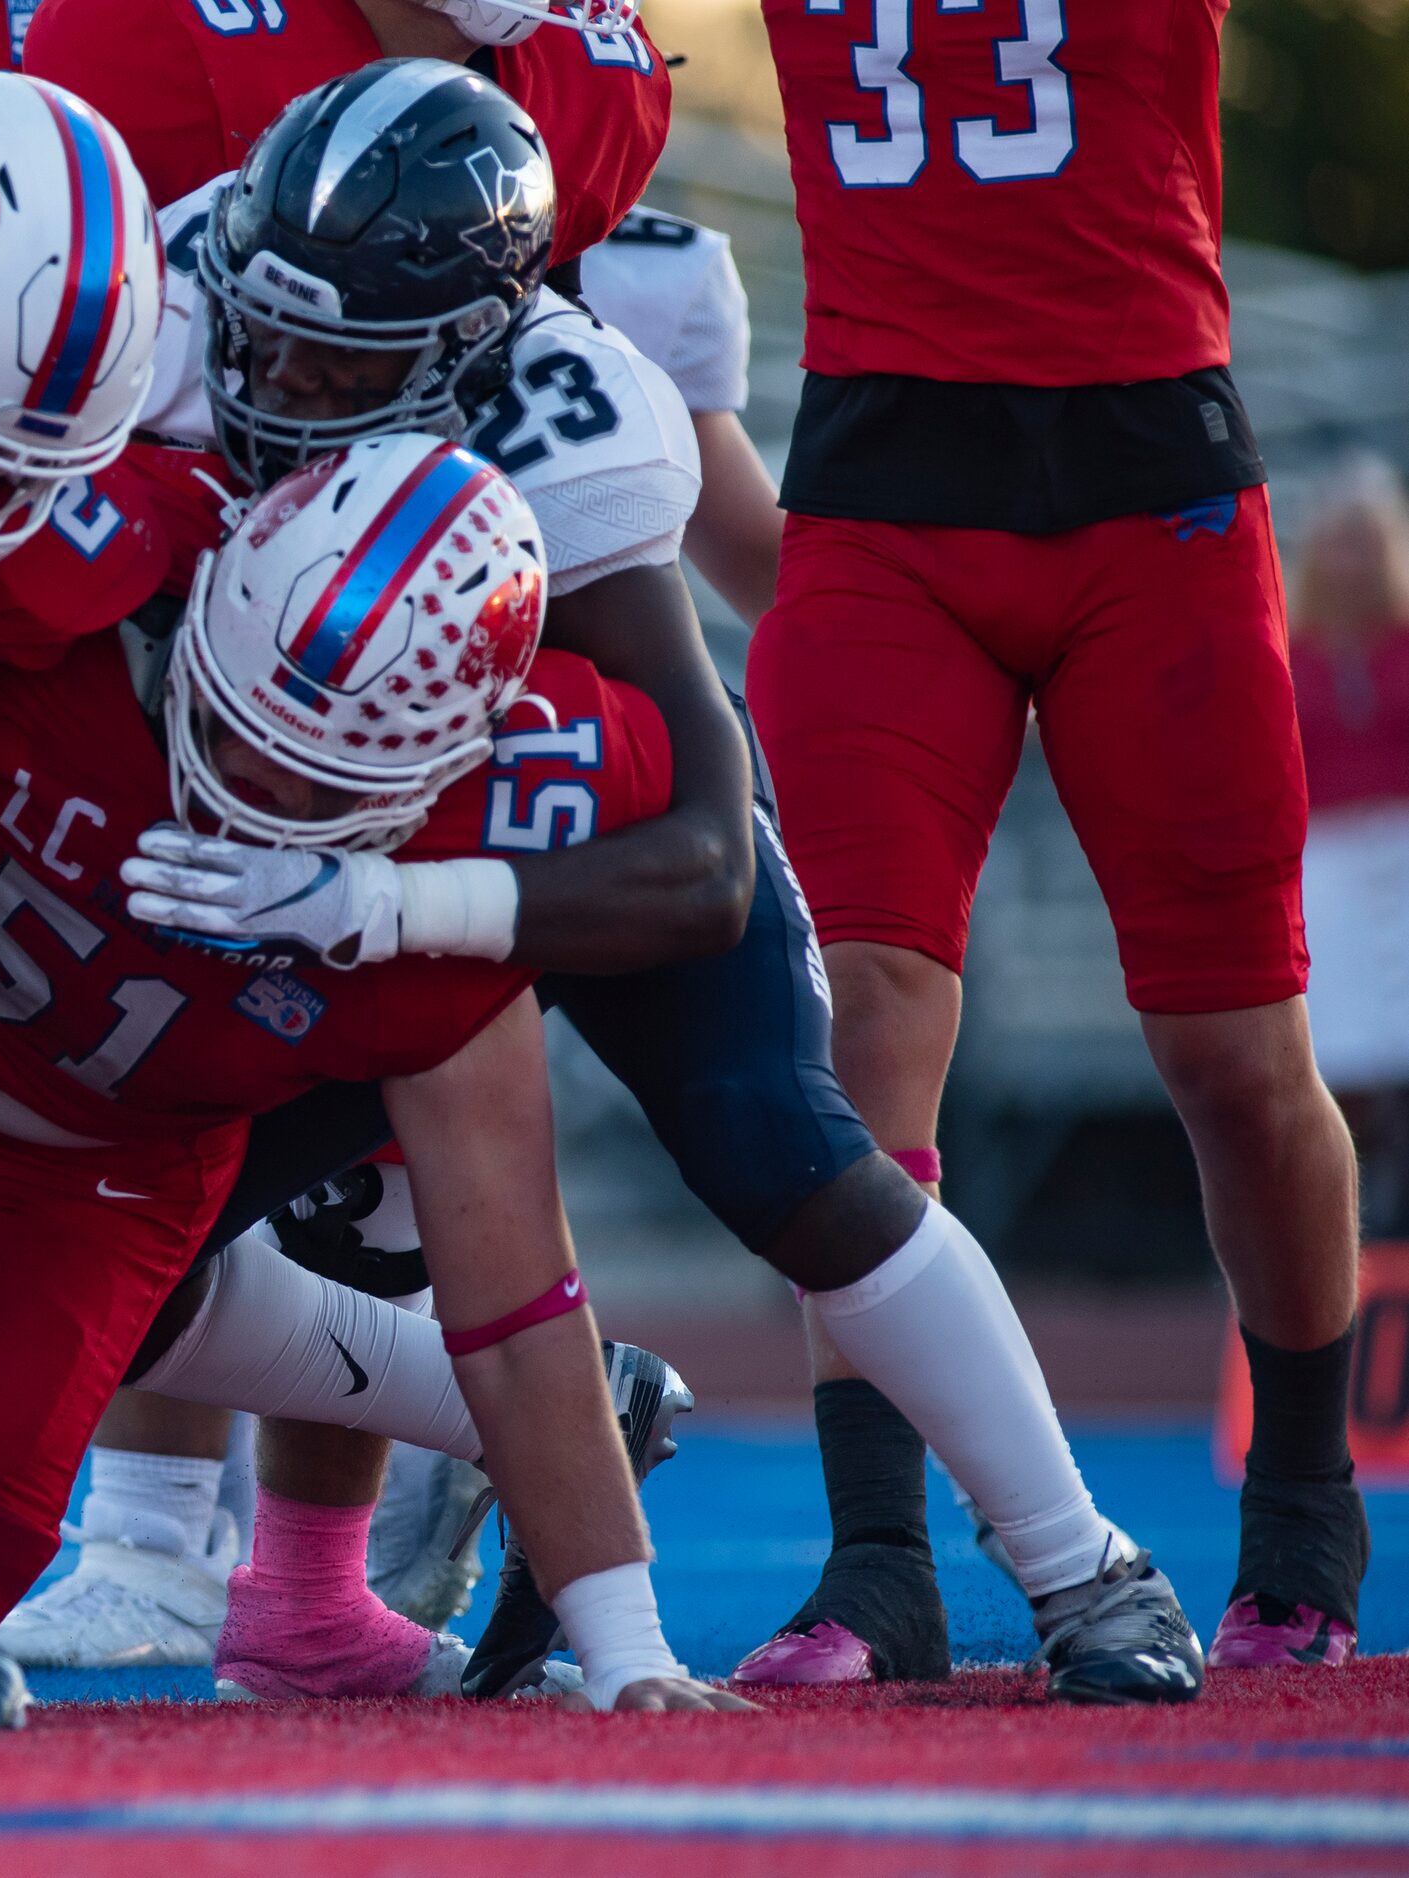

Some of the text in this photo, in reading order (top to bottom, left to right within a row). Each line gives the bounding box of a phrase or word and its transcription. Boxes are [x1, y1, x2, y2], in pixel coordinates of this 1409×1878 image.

[805, 0, 1079, 189] 33
[264, 263, 321, 307] BE-ONE
[464, 348, 623, 478] 23
[251, 684, 325, 740] Riddell
[481, 716, 603, 854] 51
[236, 977, 311, 1038] 50
[268, 970, 326, 1018] ARISH
